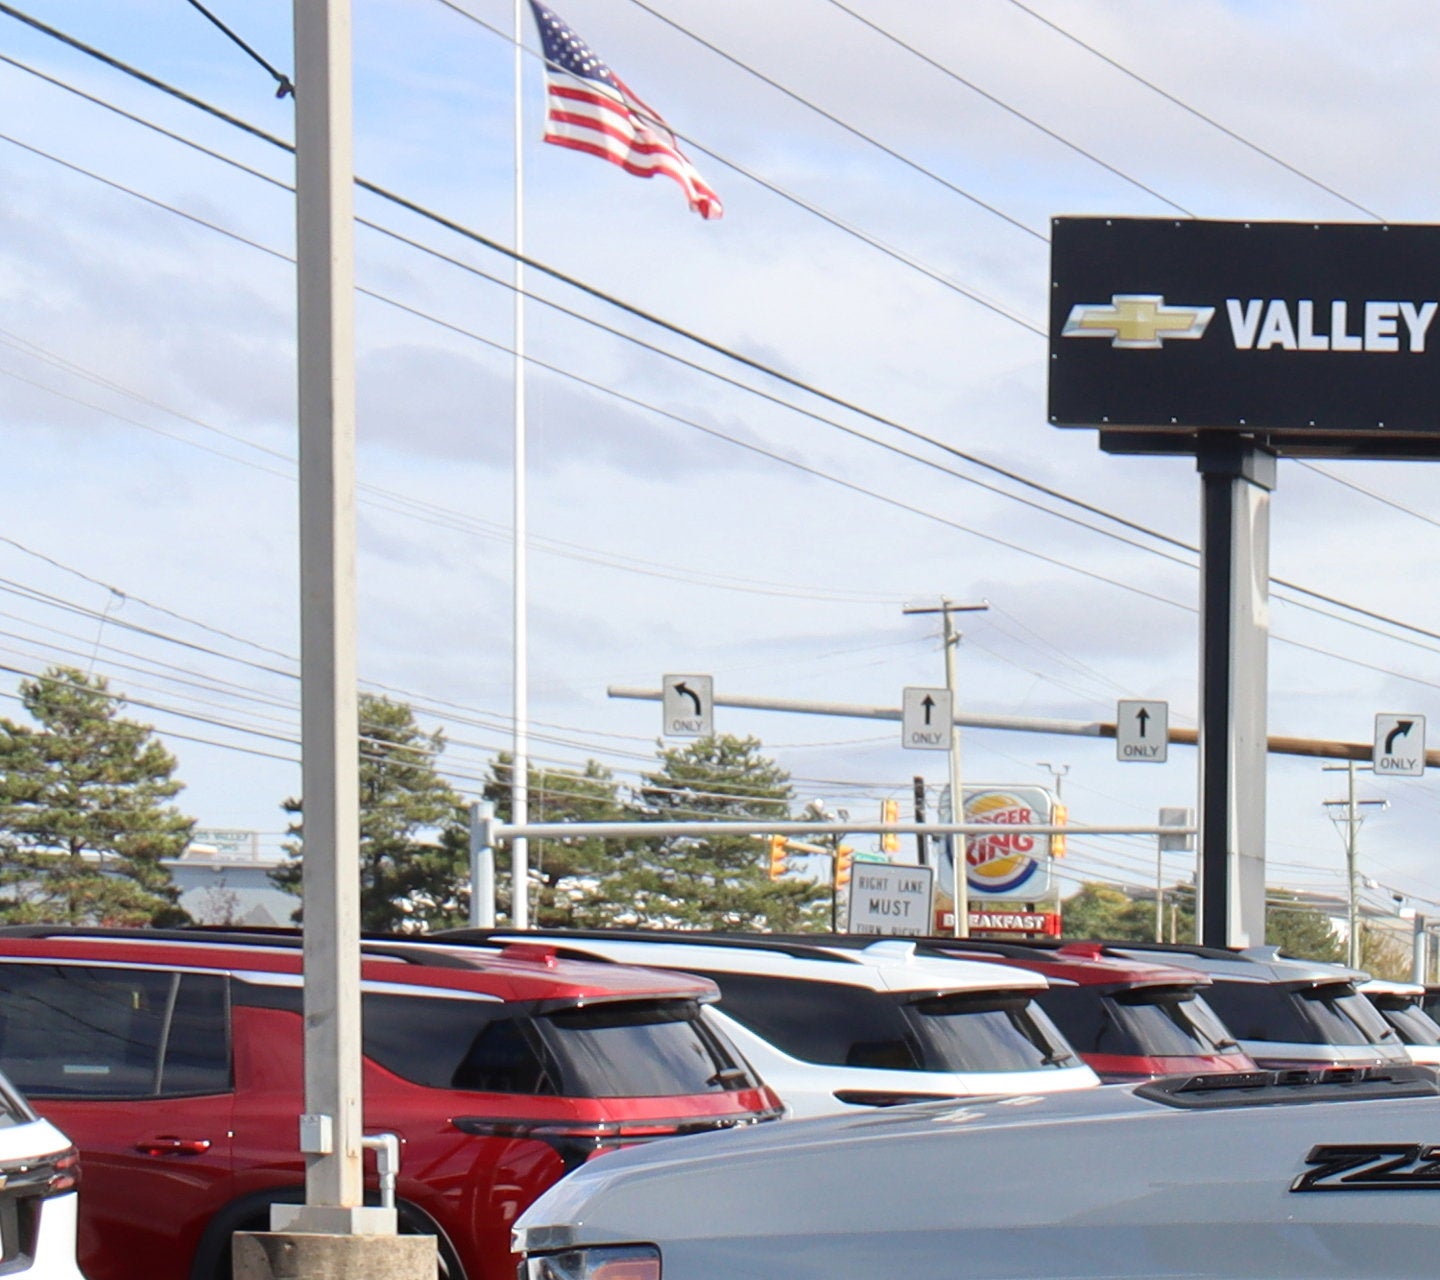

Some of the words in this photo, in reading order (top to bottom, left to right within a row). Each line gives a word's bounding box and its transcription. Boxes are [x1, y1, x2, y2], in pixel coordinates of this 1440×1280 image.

[1226, 299, 1438, 352] VALLEY
[672, 719, 704, 732] ONLY
[911, 731, 943, 745] ONLY
[1123, 745, 1160, 758] ONLY
[1380, 757, 1417, 770] ONLY
[859, 876, 888, 891] RIGHT
[898, 879, 924, 895] LANE
[869, 898, 911, 917] MUST
[943, 912, 1045, 929] BEAKFAST
